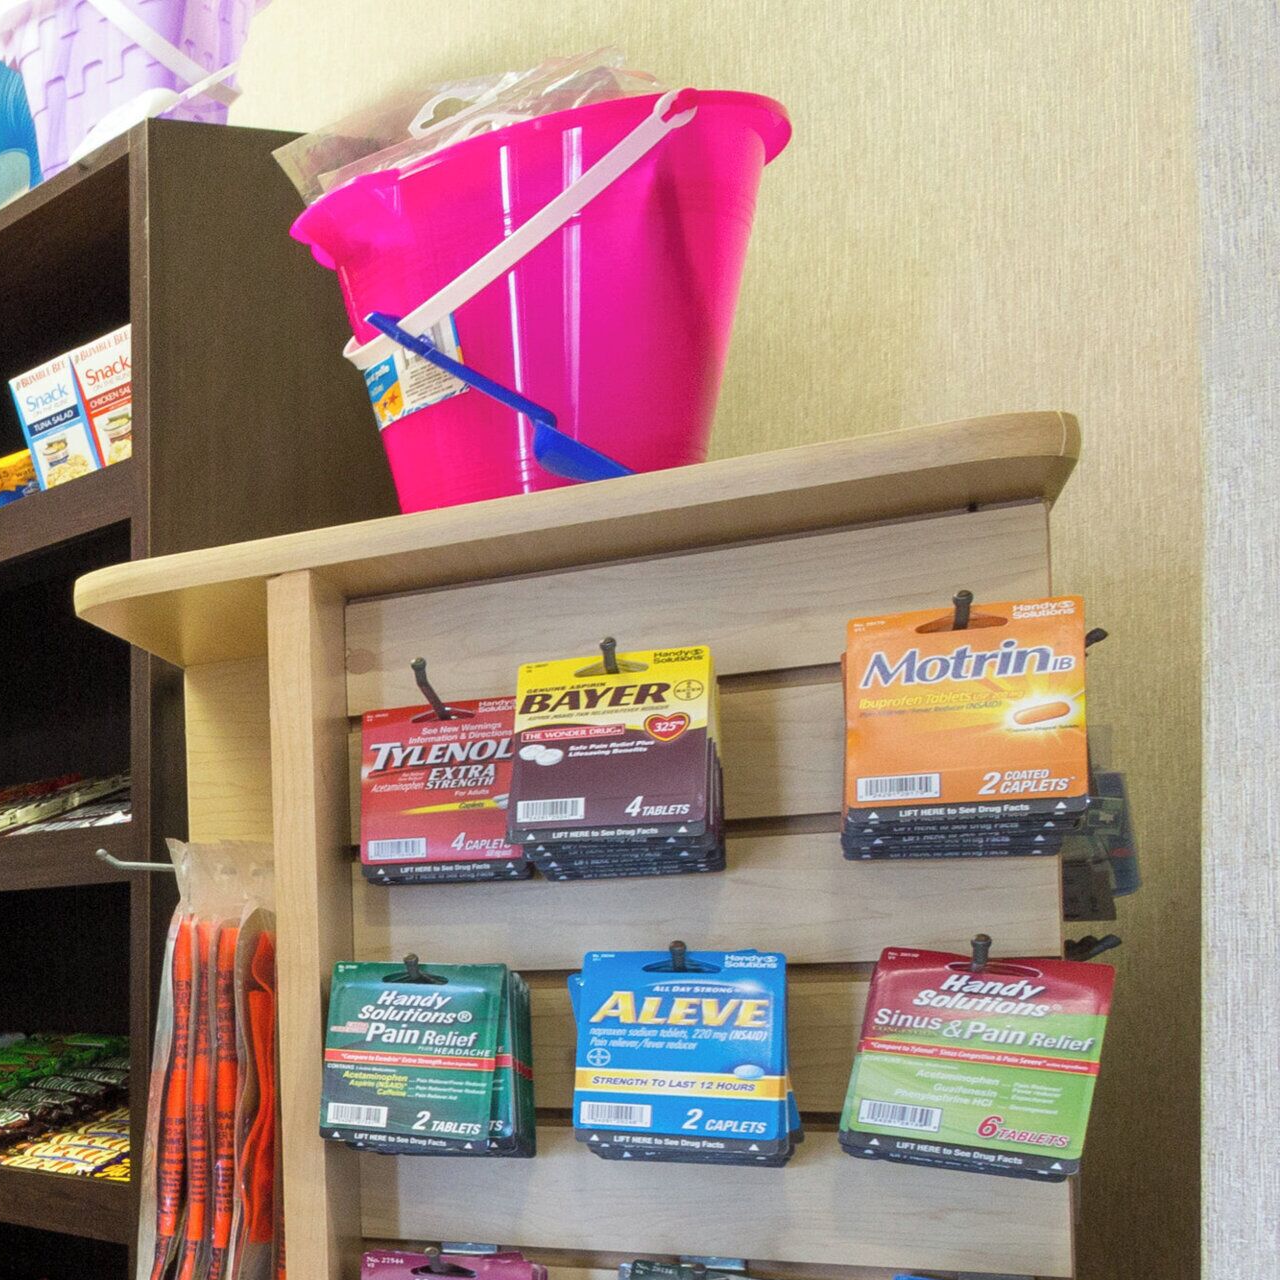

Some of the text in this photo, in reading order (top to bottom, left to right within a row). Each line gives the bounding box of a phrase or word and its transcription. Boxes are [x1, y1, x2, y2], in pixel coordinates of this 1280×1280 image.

[79, 331, 129, 361] BUMBLE BEE
[85, 355, 131, 386] Snack
[26, 383, 69, 412] Snack
[33, 409, 74, 432] TUNA SALAD
[859, 640, 1076, 689] Motrin IB
[519, 682, 671, 715] BAYER
[858, 692, 971, 710] Ibuprofen Tablets
[525, 727, 616, 740] THE WONDER DRUG
[369, 738, 514, 772] TYLENOL
[425, 778, 494, 790] STRENGTH
[429, 764, 496, 780] EXTRA
[978, 771, 1001, 795] 2
[1004, 769, 1049, 780] COATED
[1000, 777, 1069, 794] CAPLETS
[625, 795, 690, 817] 4 TABLETS
[724, 961, 778, 969] Solutions
[941, 974, 1045, 999] Handy
[377, 991, 451, 1009] Handy
[590, 991, 769, 1028] ALEVE
[912, 989, 1050, 1017] Solutions
[366, 1022, 419, 1045] Pain
[422, 1032, 477, 1047] Relief
[874, 1007, 1094, 1052] Sinus & Pain Relief
[342, 1070, 408, 1082] Acetaminophen
[592, 1076, 648, 1086] STRENGTH
[652, 1079, 665, 1087] TO
[716, 1083, 756, 1092] HOURS
[412, 1111, 481, 1135] 2 TABLETS
[682, 1108, 767, 1134] 2 CAPLETS
